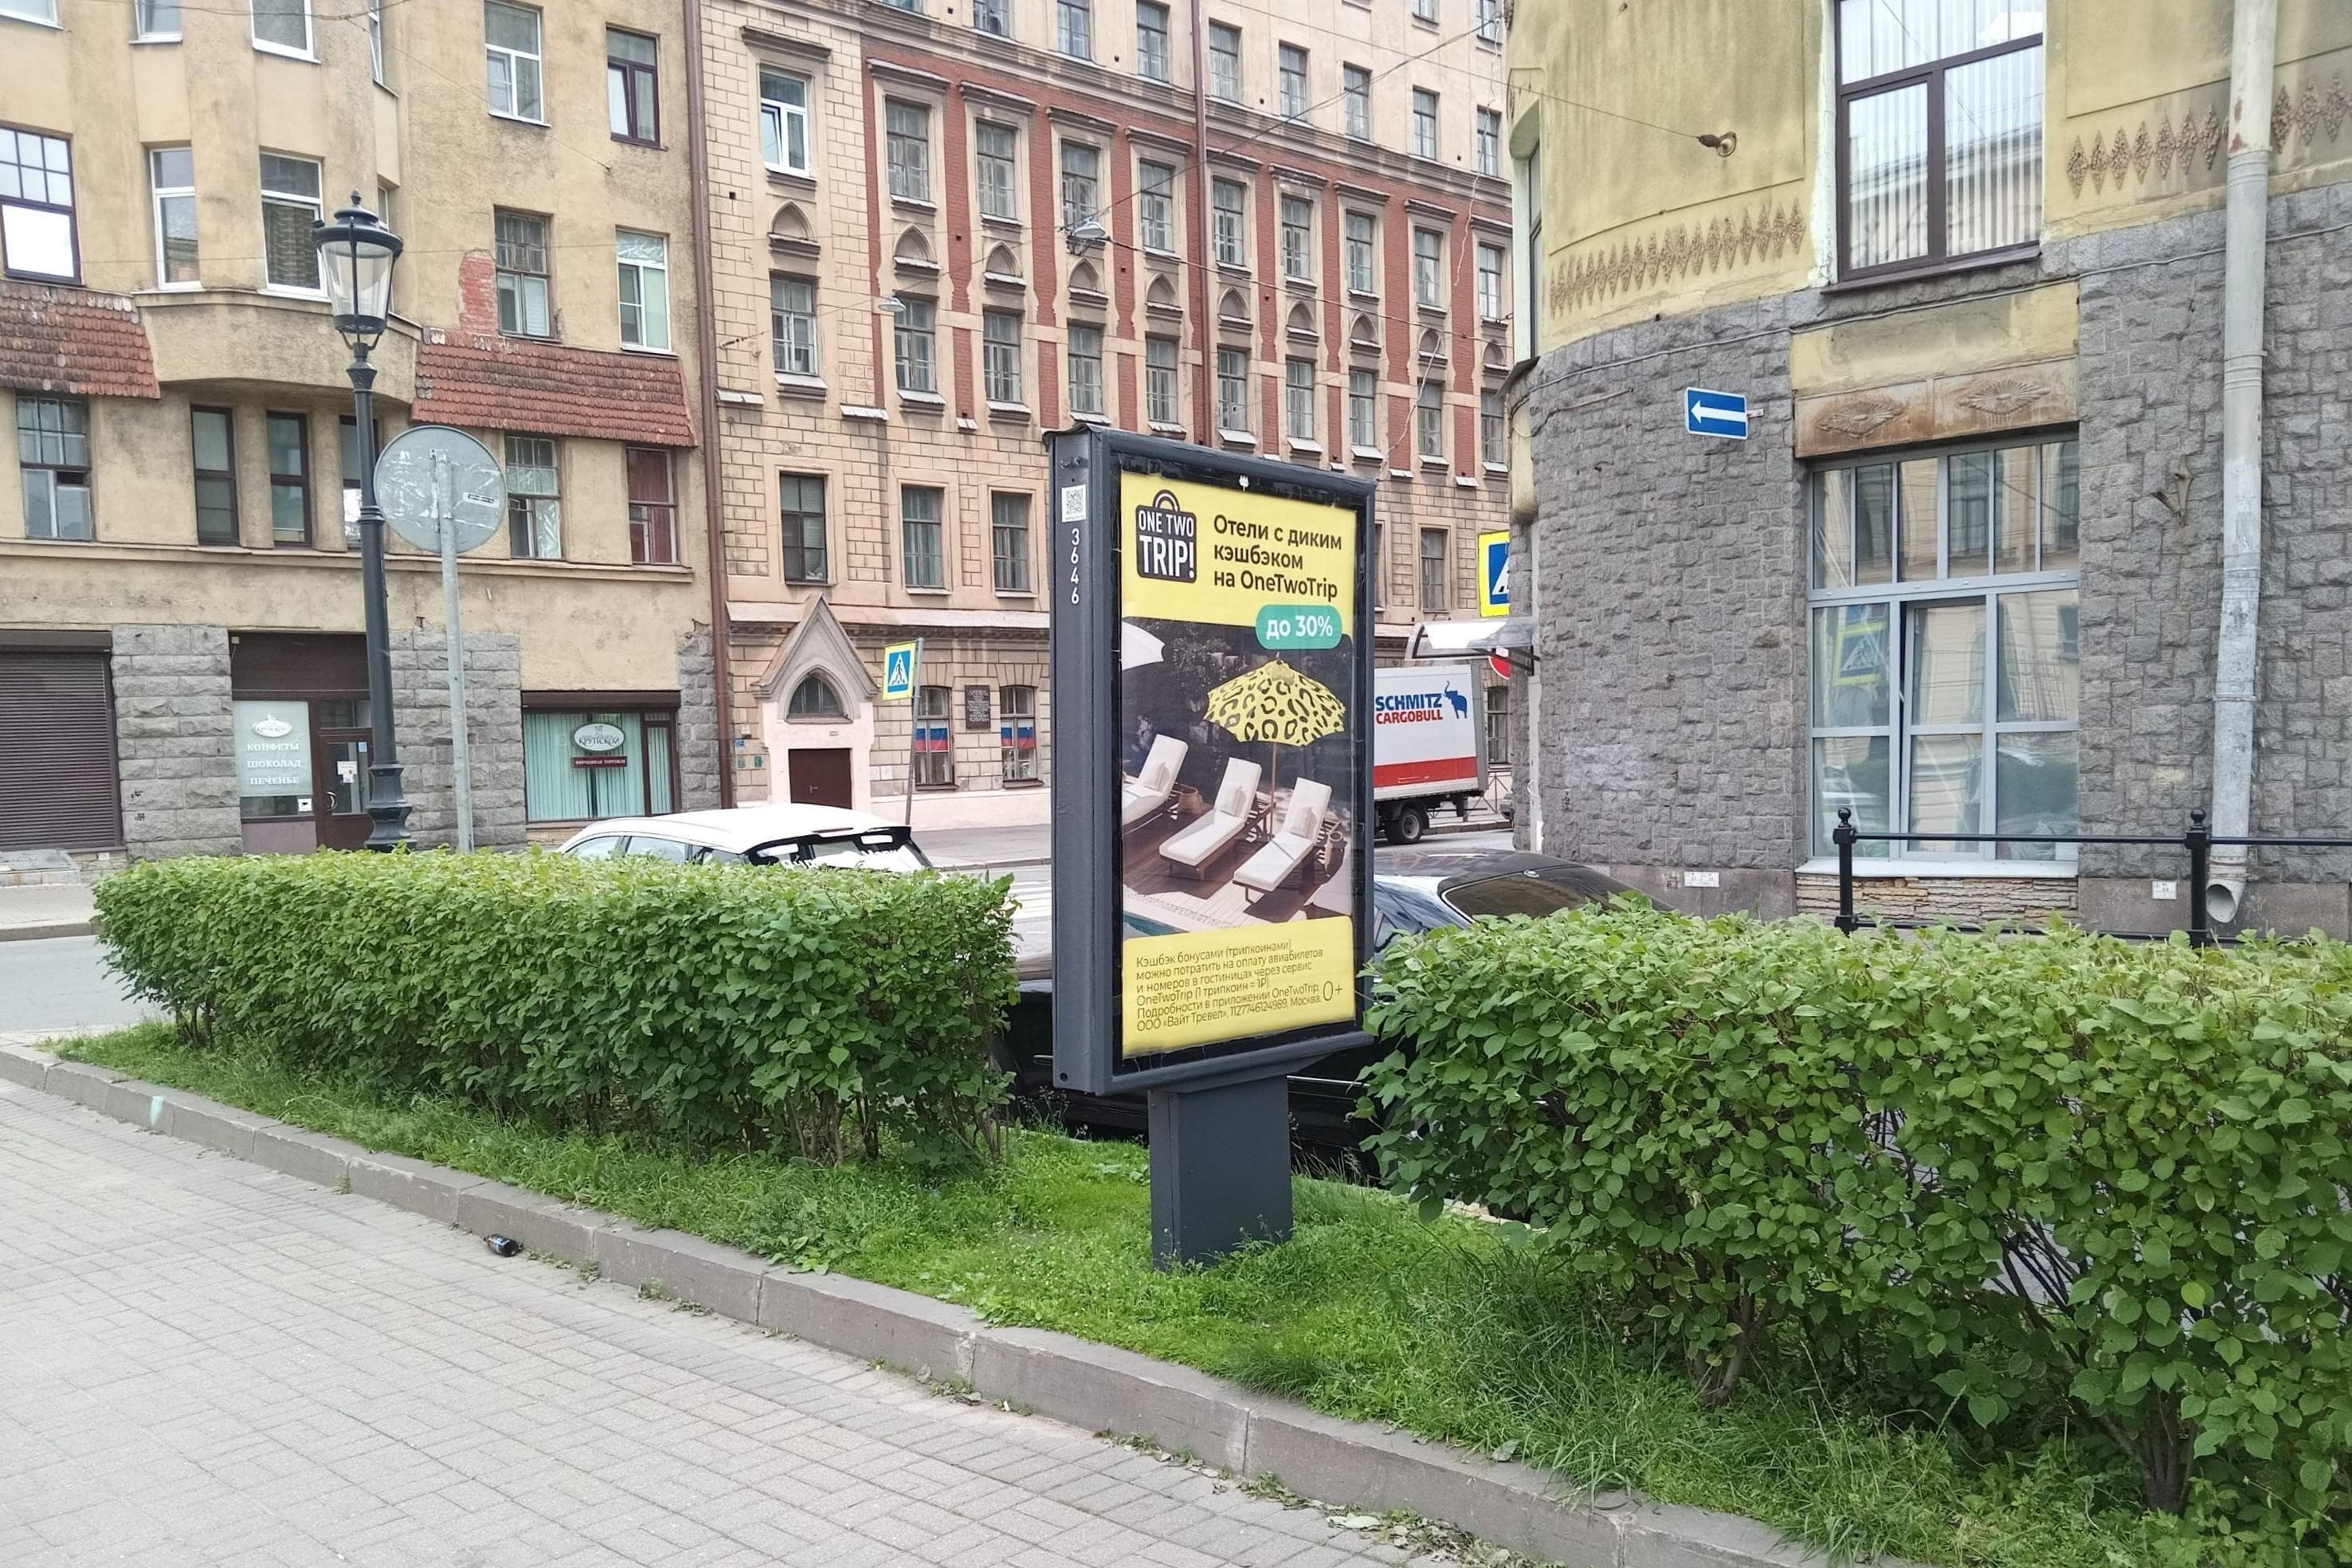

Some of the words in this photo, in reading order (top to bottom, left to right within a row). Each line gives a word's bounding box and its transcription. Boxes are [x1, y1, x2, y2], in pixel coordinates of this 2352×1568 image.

[1139, 510, 1162, 533] ONE
[1166, 514, 1194, 537] TWO
[1213, 514, 1268, 540] Отели
[1274, 527, 1284, 542] с
[1288, 529, 1342, 550] диким
[1139, 535, 1194, 578] TRIP!
[1214, 544, 1303, 570] кэшбэком
[1214, 570, 1235, 588] на
[1241, 570, 1338, 602] OneTwoTrip
[1266, 619, 1291, 640] до
[1295, 615, 1333, 637] 30%
[1375, 693, 1442, 711] SCHMITZ
[1376, 709, 1443, 724] CARGOBULL
[246, 743, 300, 751] КОНФЕТЫ
[247, 759, 301, 768] ШОКОЛАД
[249, 776, 300, 785] ПЕЧЕНЬЕ
[1136, 954, 1175, 968] Кэшбэк
[1178, 950, 1223, 963] бонусами
[1226, 939, 1291, 958] (трипкоинами)
[1136, 968, 1171, 981] можно
[1174, 962, 1221, 975] потратить
[1223, 960, 1233, 969] на
[1236, 956, 1266, 968] оплату
[1268, 949, 1323, 963] авиабилетов
[1136, 985, 1143, 994] и
[1147, 978, 1190, 992] номеров
[1193, 978, 1198, 986] в
[1200, 970, 1252, 985] гостиницах
[1255, 966, 1280, 977] через
[1282, 962, 1312, 974] сервис
[1137, 990, 1193, 1006] OneTwoTrip
[1203, 982, 1248, 997] трипкоин
[1323, 981, 1343, 1001] 0+
[1138, 1002, 1202, 1019] Подробности
[1205, 1000, 1210, 1009] в
[1213, 992, 1270, 1009] приложении
[1137, 1017, 1162, 1032] ООО
[1163, 1015, 1190, 1027] «Вайт
